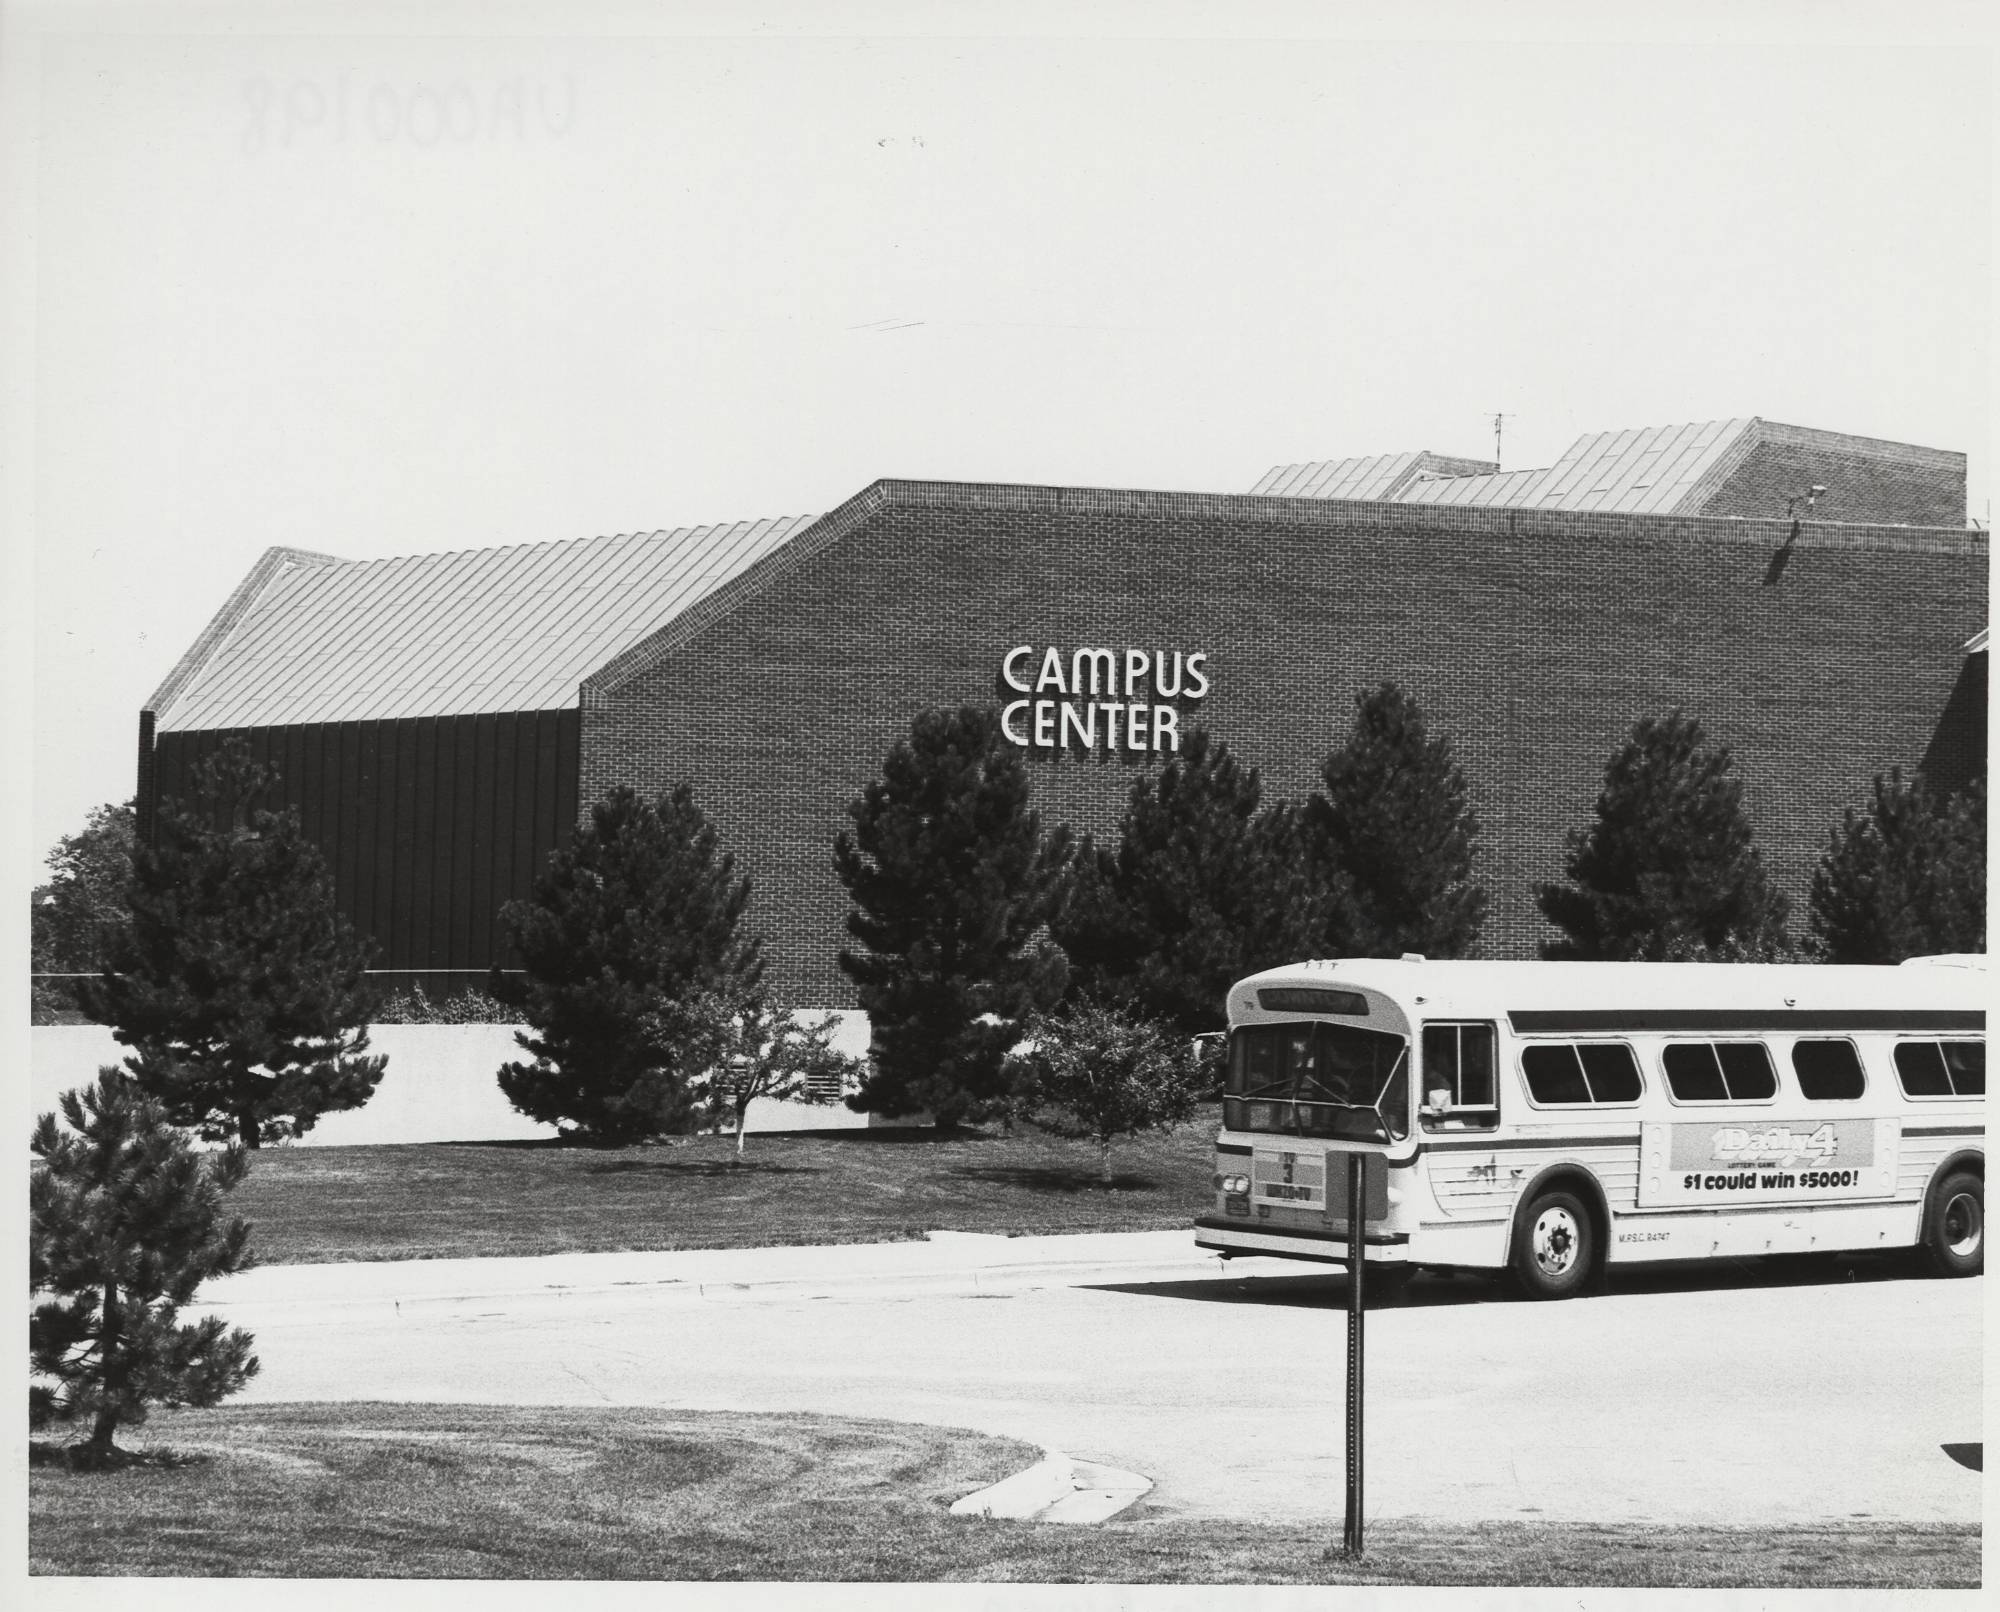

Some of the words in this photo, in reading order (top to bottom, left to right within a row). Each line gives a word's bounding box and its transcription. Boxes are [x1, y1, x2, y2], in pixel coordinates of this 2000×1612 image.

[1002, 645, 1210, 698] CAMPUS
[1001, 699, 1179, 751] CENTER
[1711, 1124, 1810, 1164] Daily
[1807, 1122, 1839, 1162] 4
[1684, 1173, 1701, 1190] $1
[1704, 1172, 1757, 1190] could
[1761, 1172, 1795, 1189] win
[1800, 1170, 1859, 1188] $5000!
[1757, 1161, 1776, 1169] GAME
